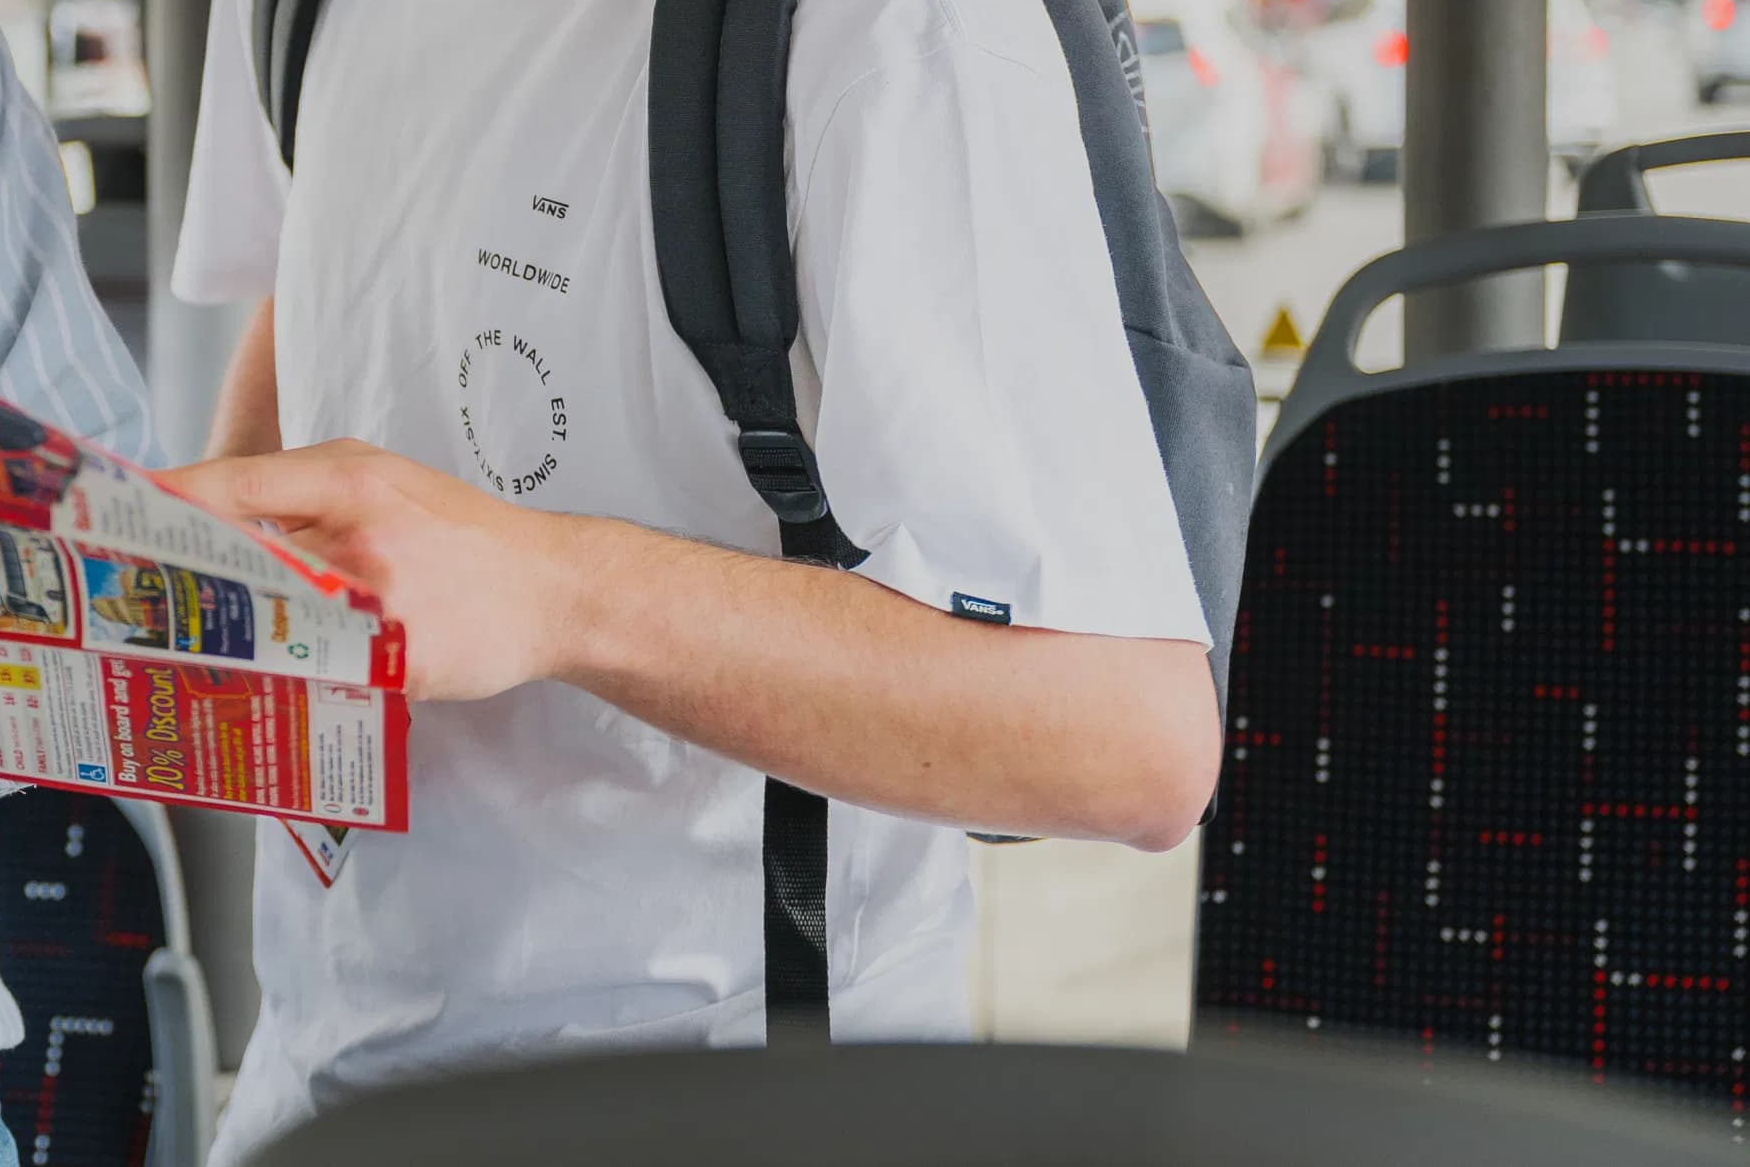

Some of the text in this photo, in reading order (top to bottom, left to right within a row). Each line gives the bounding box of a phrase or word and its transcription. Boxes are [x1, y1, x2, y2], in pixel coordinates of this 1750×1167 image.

[532, 194, 569, 219] VANS
[477, 248, 571, 294] WORLDWIDE
[475, 330, 502, 350] THE
[512, 335, 552, 386] WALL
[458, 349, 472, 388] OFF
[550, 396, 567, 442] EST.
[512, 453, 558, 495] SINCE
[961, 599, 997, 615] VANS
[109, 659, 141, 783] Buy on board and get
[144, 667, 184, 790] 10% Discount
